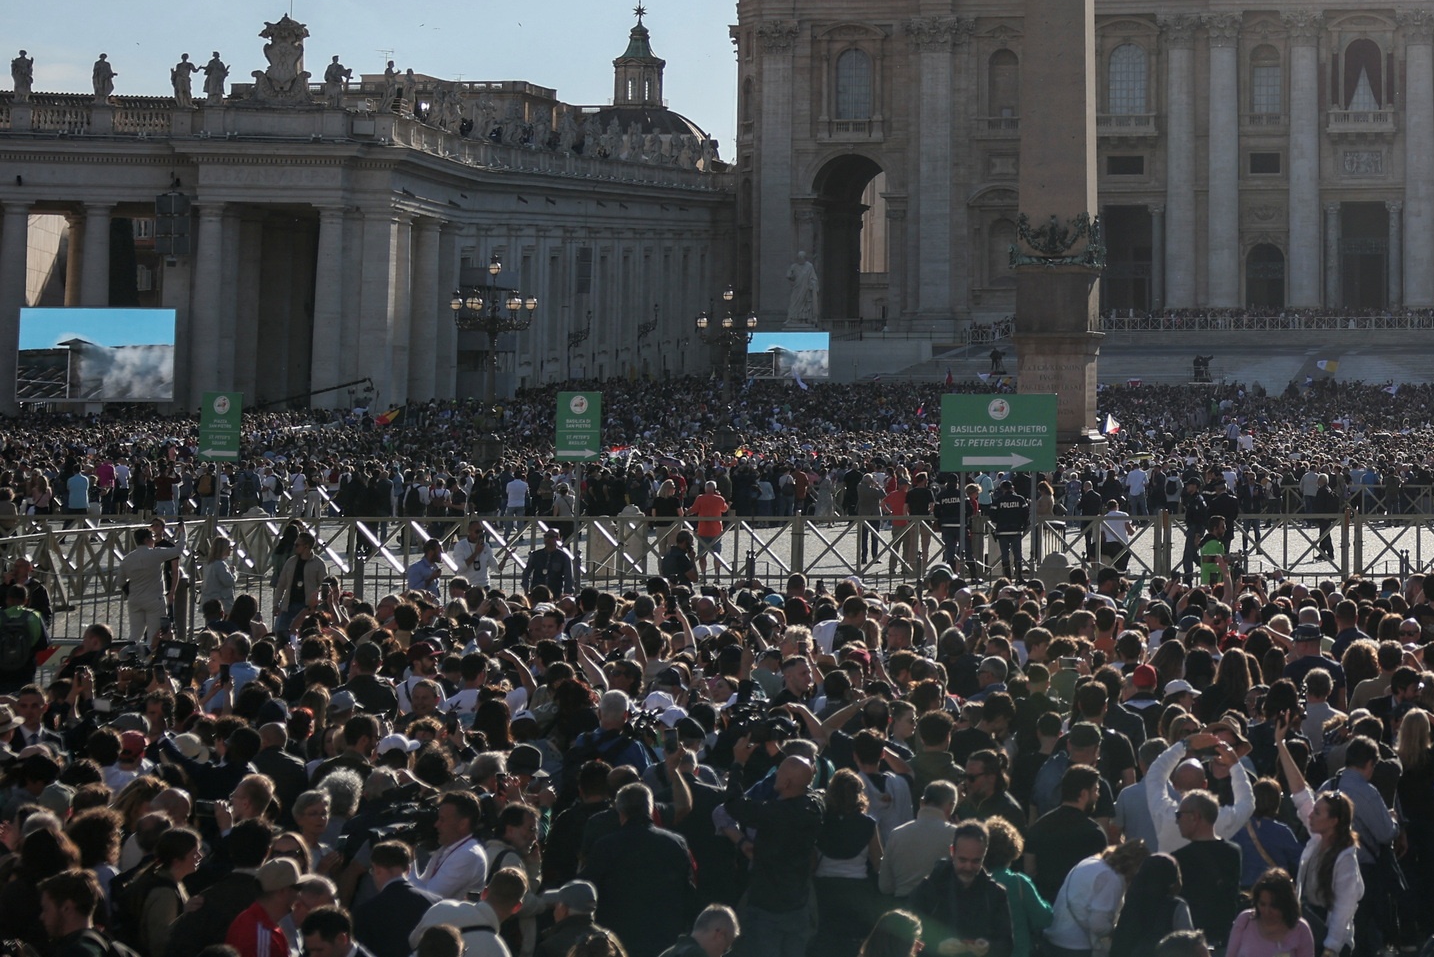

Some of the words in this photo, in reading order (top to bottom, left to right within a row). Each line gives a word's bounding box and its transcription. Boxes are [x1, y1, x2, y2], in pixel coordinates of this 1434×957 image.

[950, 425, 988, 433] BASILICA
[989, 425, 998, 433] DI
[999, 425, 1016, 433] SAN
[1017, 425, 1048, 433] PIETRO
[953, 438, 966, 447] ST.
[968, 438, 1003, 447] PETER'S
[1004, 438, 1043, 447] BASILICA
[941, 497, 961, 505] POLIZIA
[999, 501, 1020, 510] POLIZIA
